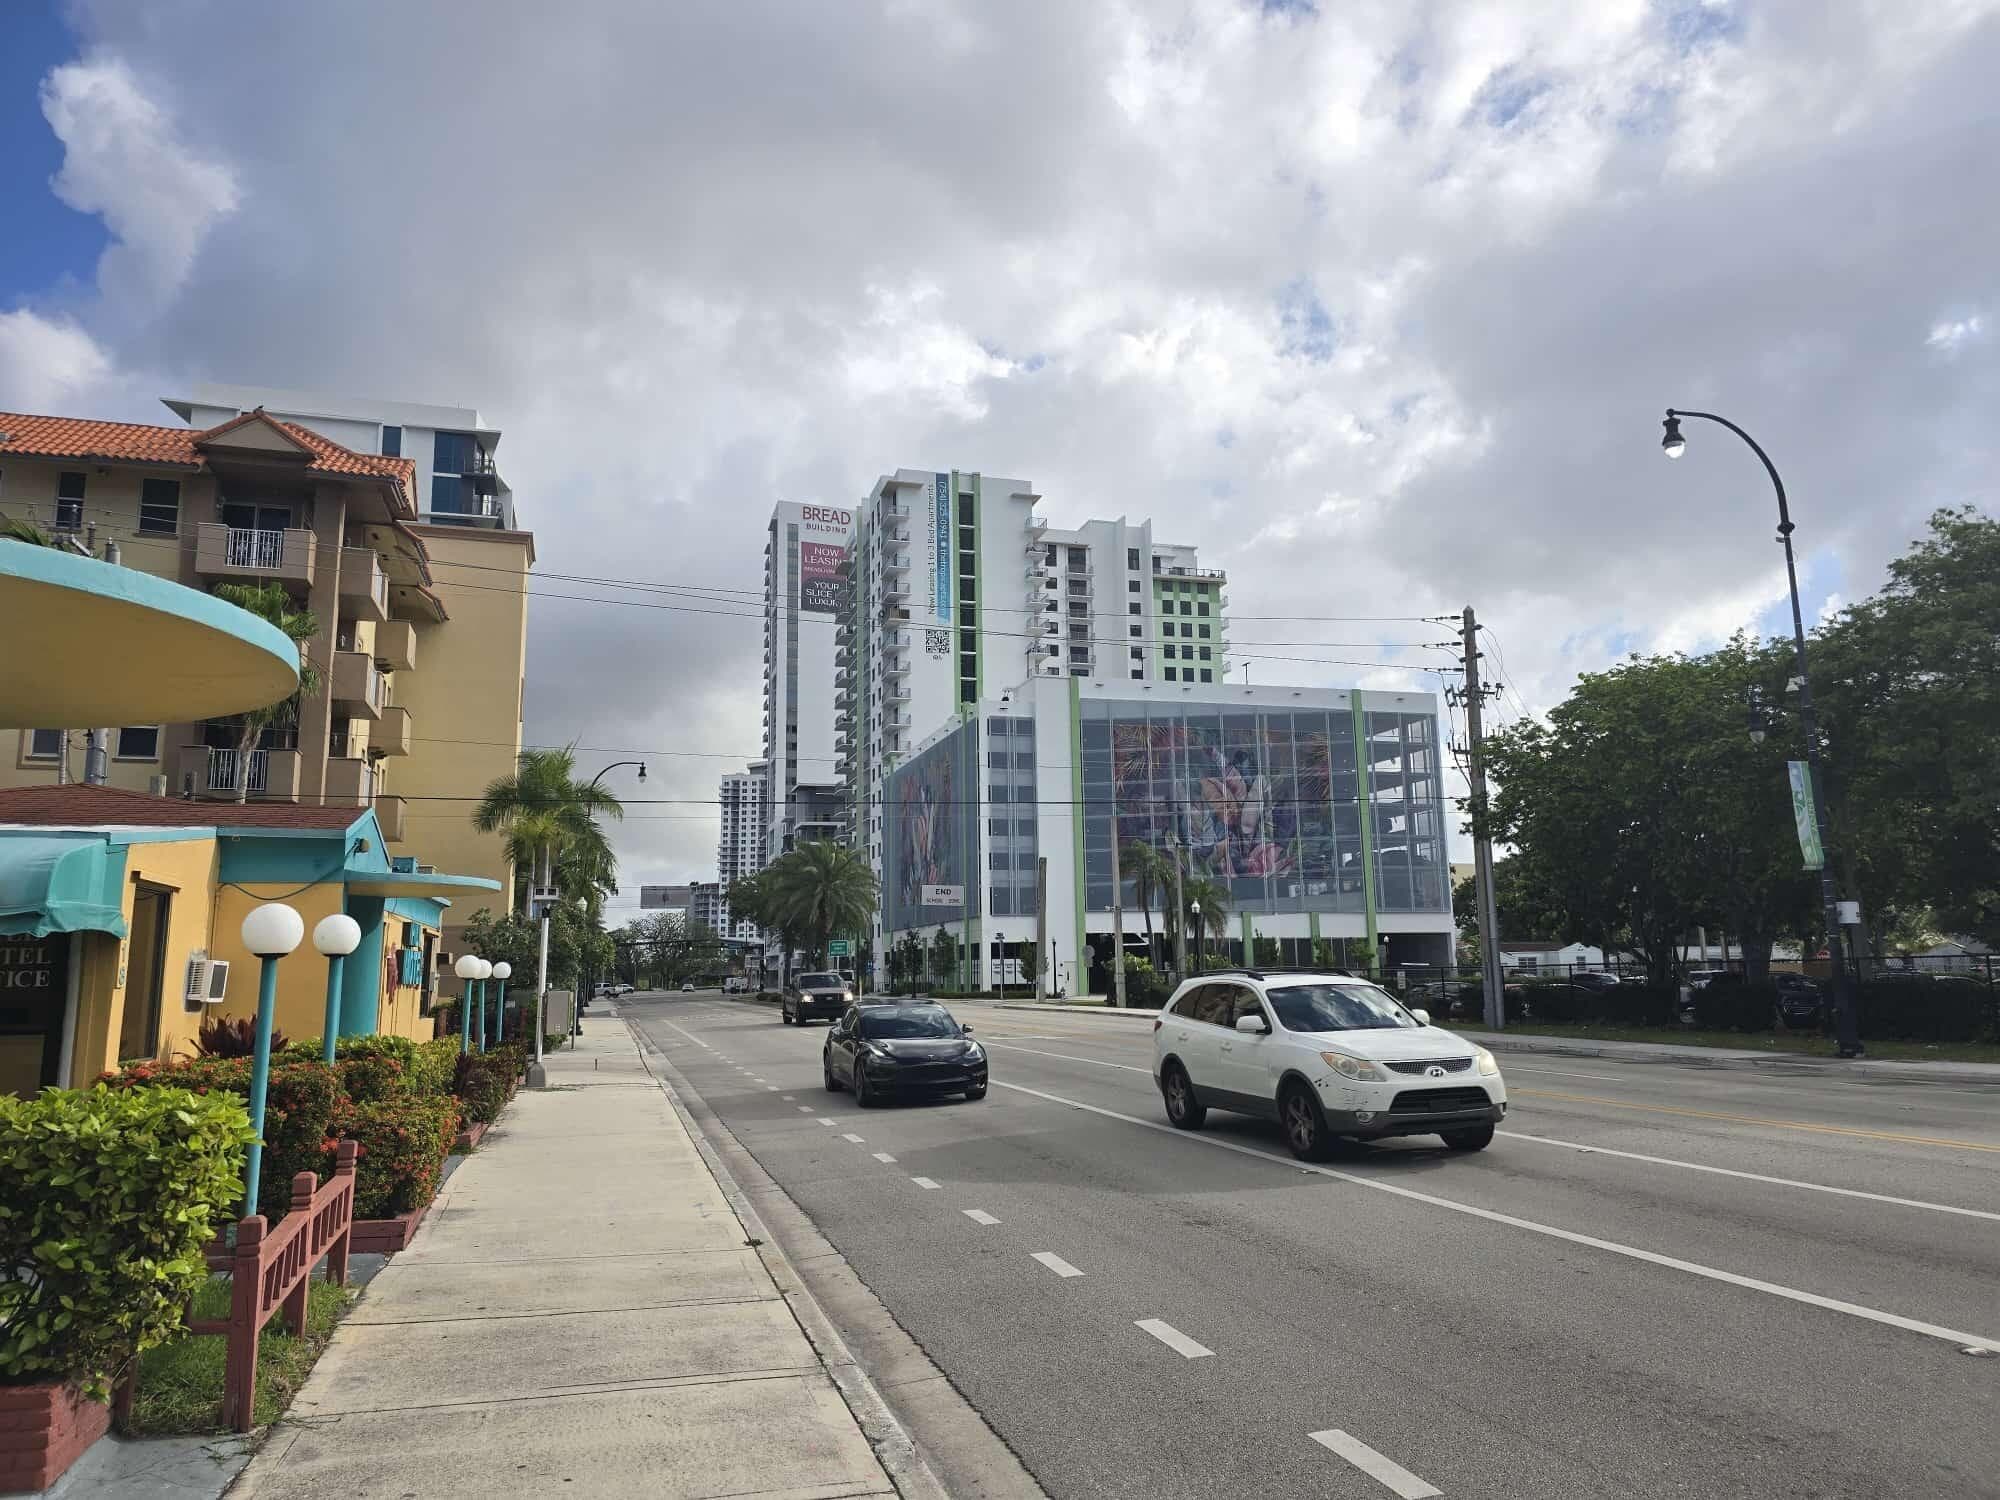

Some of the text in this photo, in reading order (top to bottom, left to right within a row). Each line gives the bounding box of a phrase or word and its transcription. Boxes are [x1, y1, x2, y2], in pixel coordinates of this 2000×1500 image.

[928, 484, 936, 528] Apartments
[803, 506, 851, 525] BREAD
[806, 522, 847, 534] BUILDING
[814, 546, 839, 557] NOW
[928, 551, 935, 560] to
[804, 552, 842, 566] LEASIN
[814, 581, 839, 590] YOUR
[928, 567, 936, 595] Leasing
[806, 588, 833, 598] SLICE
